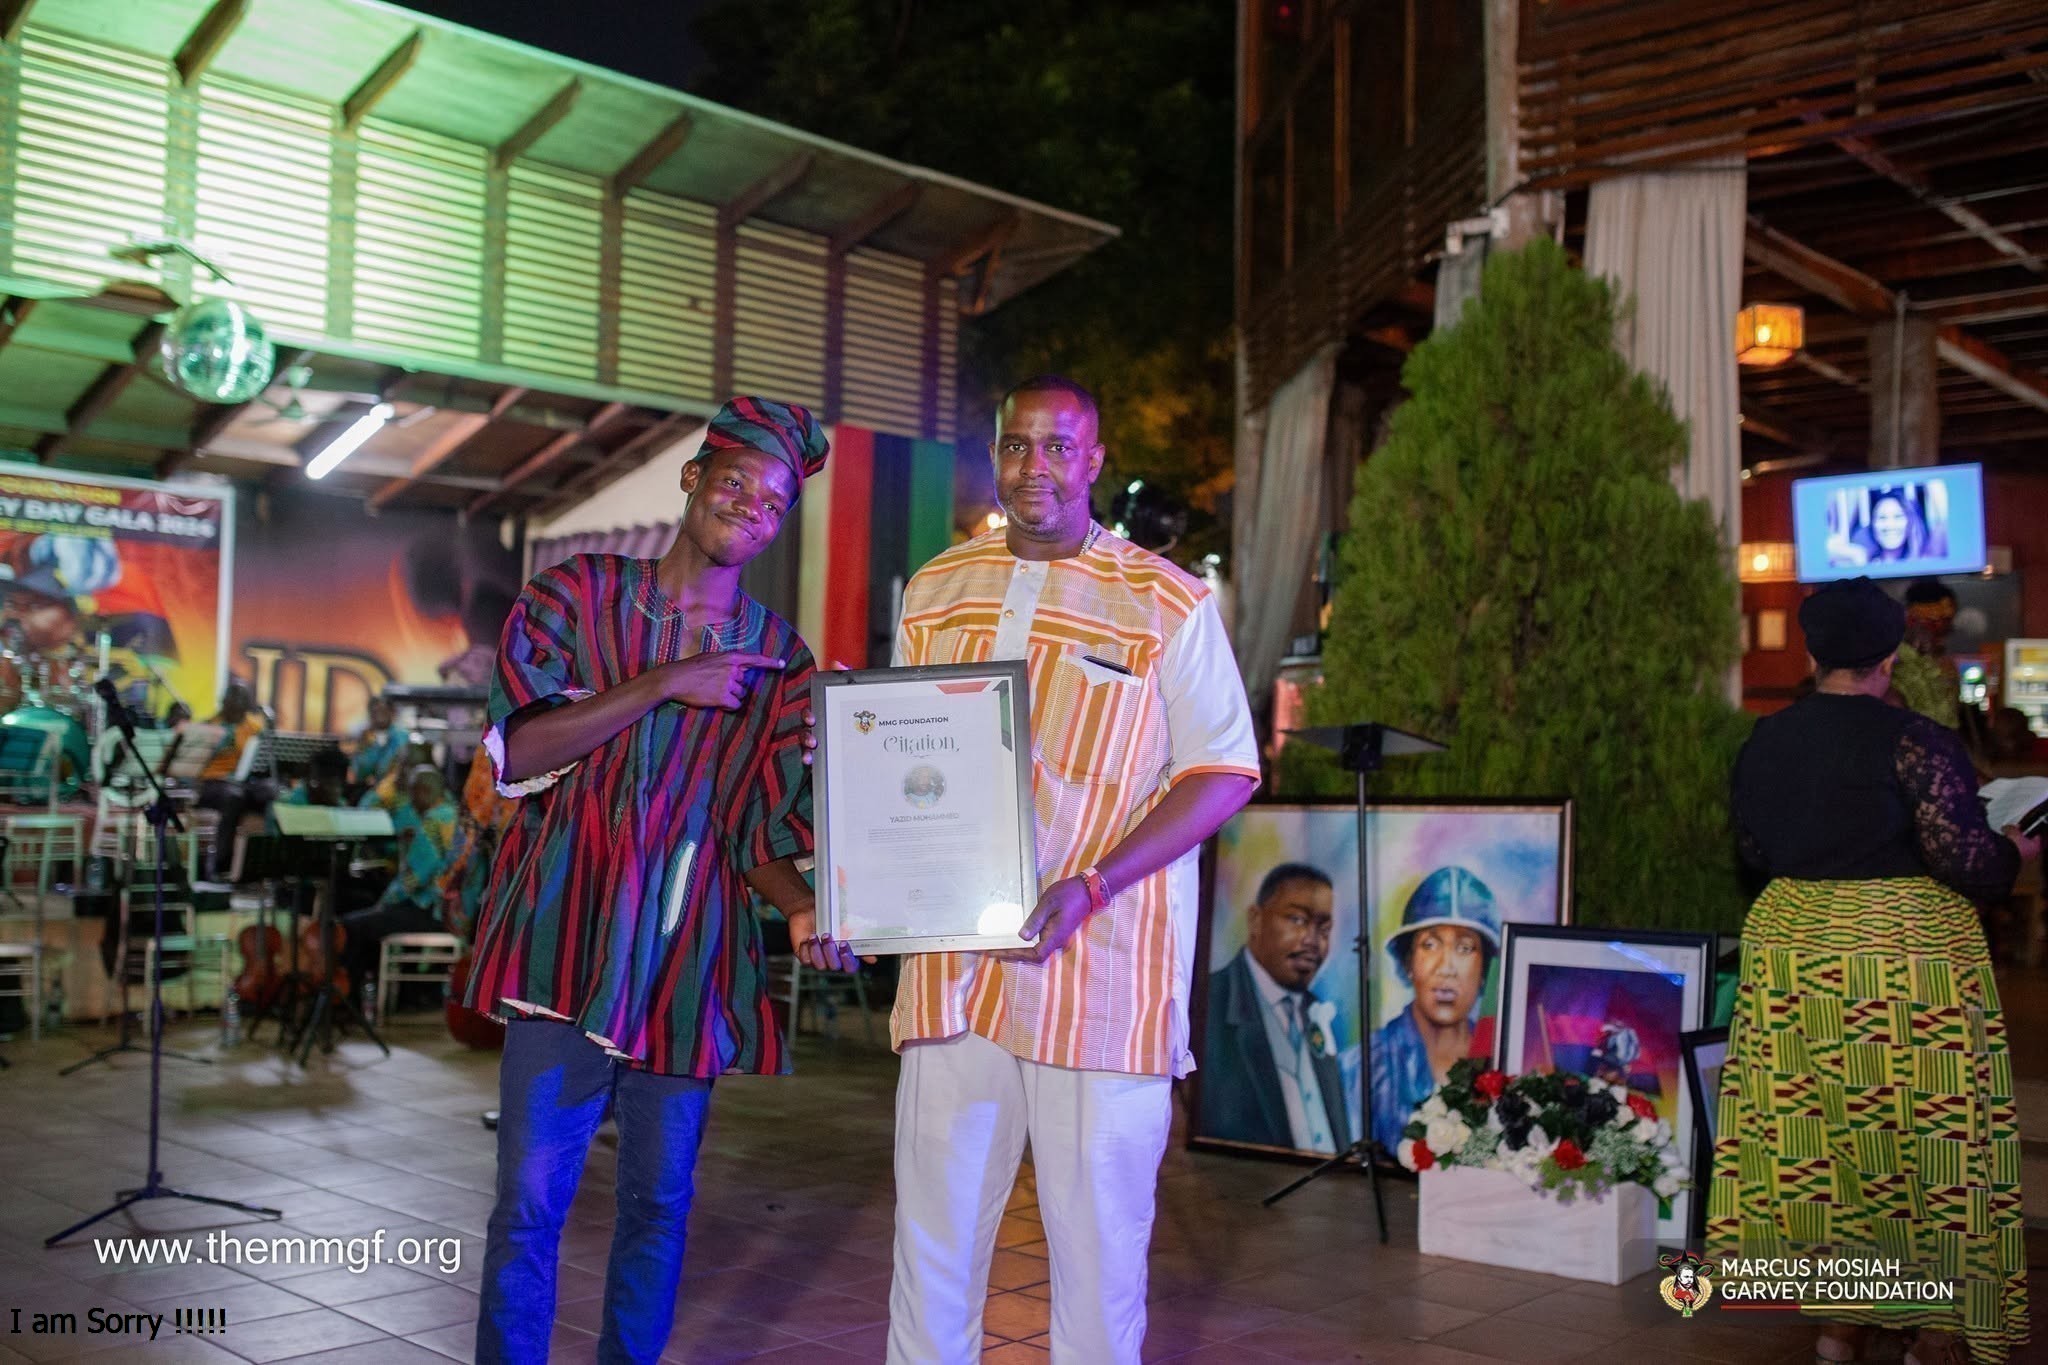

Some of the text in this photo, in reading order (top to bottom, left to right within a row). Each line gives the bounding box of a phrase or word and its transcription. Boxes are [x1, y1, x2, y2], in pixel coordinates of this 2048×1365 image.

[0, 496, 22, 518] Y
[24, 499, 84, 523] DAY
[84, 505, 156, 533] GALA
[878, 716, 949, 727] MMG FOUNDATION
[889, 812, 960, 823] YAZID MOHAMMED
